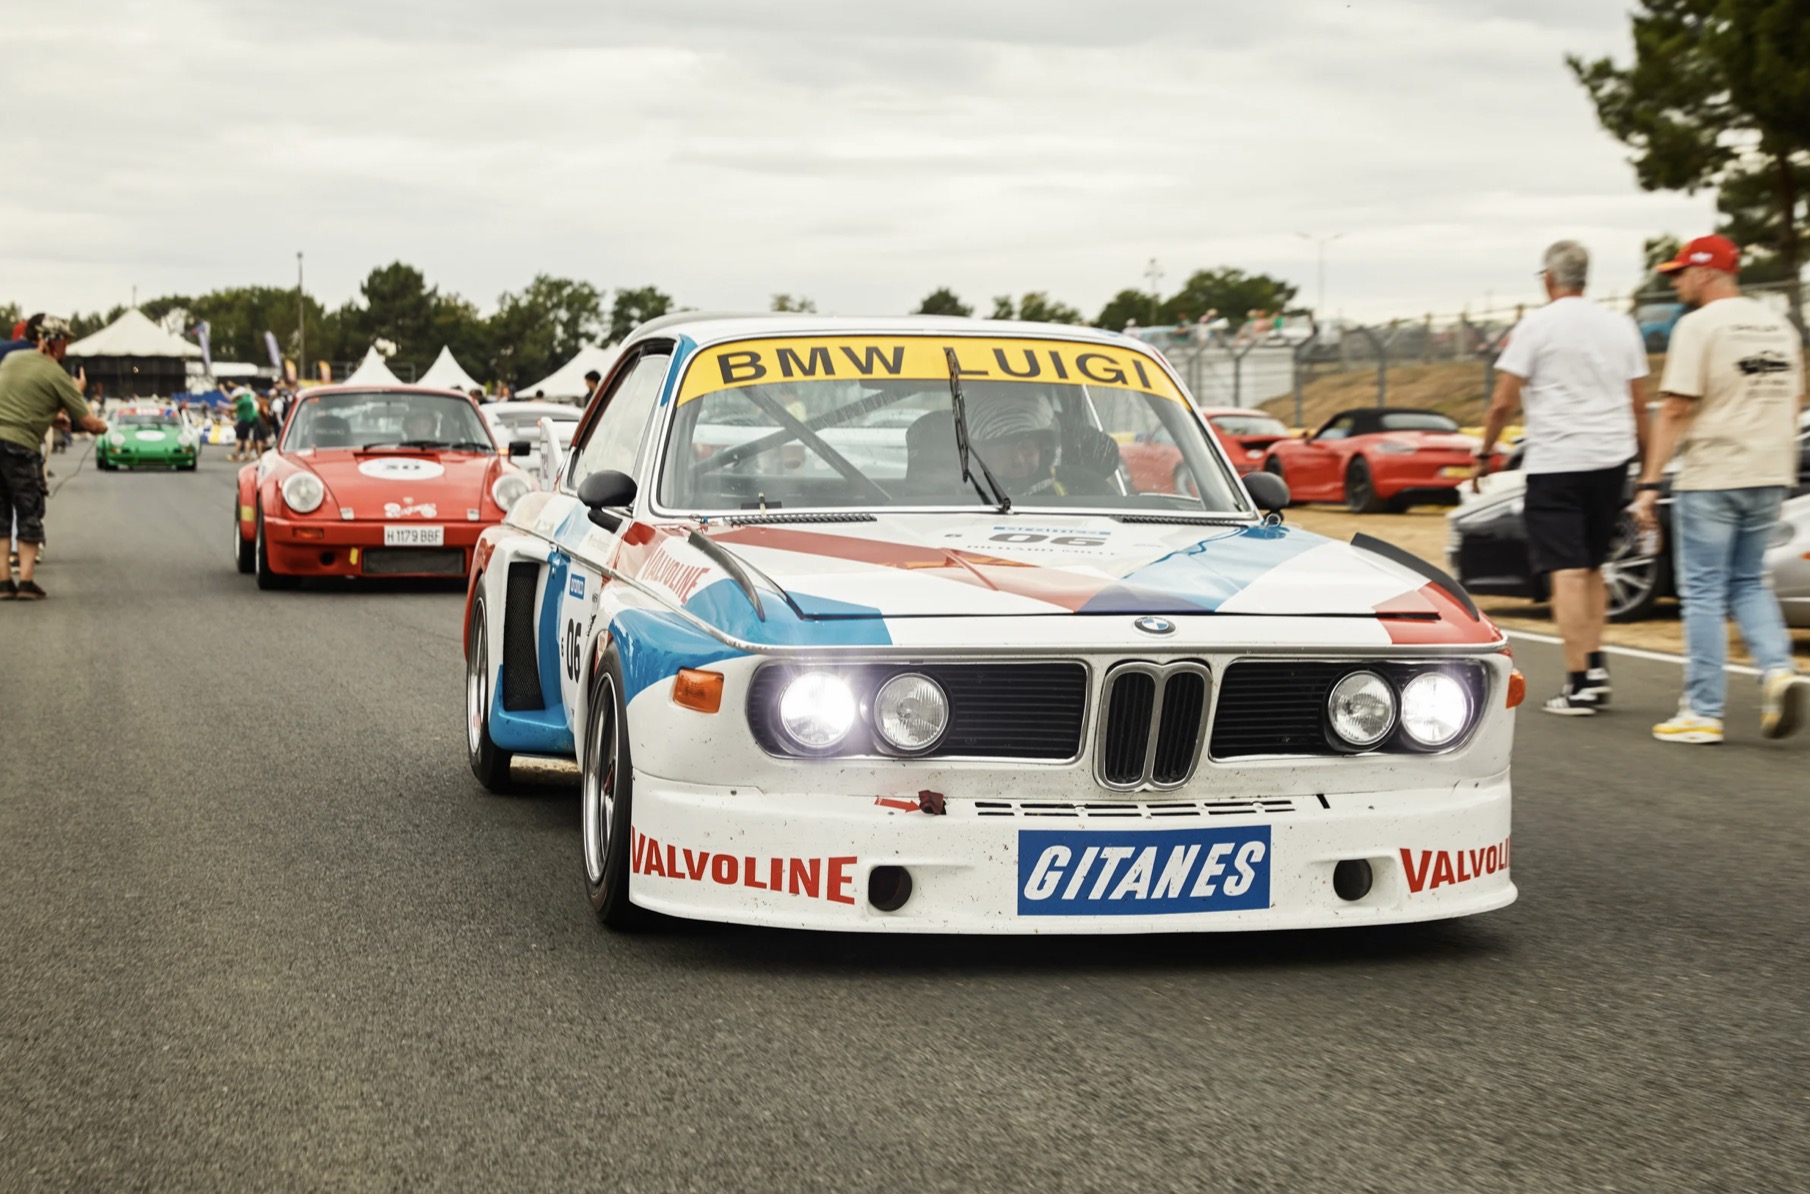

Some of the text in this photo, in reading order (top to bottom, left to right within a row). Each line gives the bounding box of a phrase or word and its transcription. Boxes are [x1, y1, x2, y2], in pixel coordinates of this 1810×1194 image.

[716, 346, 1153, 390] BMW LUIGI
[387, 529, 440, 543] H 1179 BBF
[989, 533, 1107, 546] 06
[641, 543, 710, 604] VALVOLINE
[567, 617, 582, 684] 06
[631, 825, 858, 905] VALVOLINE
[1023, 840, 1266, 900] GITANES
[1399, 835, 1511, 893] VALVOLI
